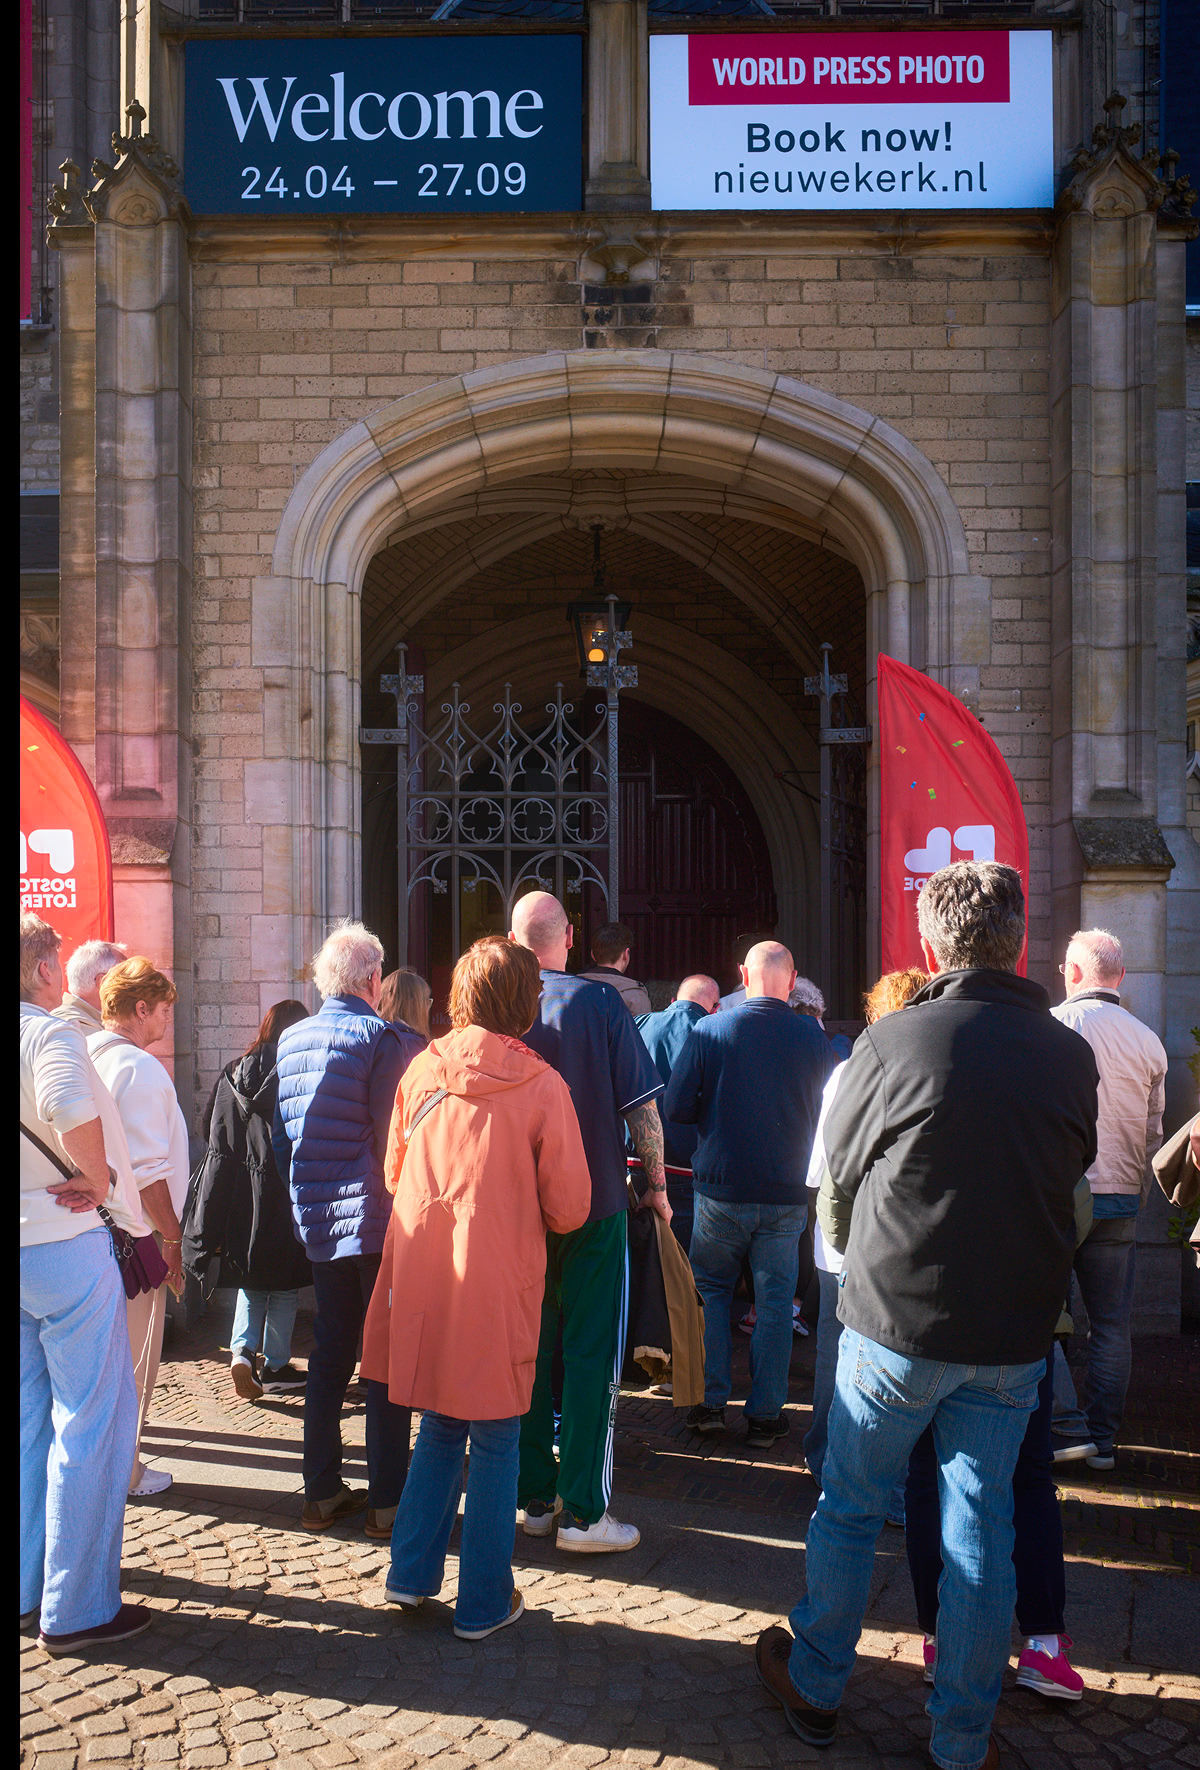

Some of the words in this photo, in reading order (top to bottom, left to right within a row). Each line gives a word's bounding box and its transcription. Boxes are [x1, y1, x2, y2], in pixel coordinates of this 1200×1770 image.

[712, 57, 806, 86] WORLD
[813, 56, 891, 85] PRESS
[898, 55, 985, 84] PHOTO
[215, 71, 544, 143] Welcome
[746, 121, 847, 153] Book
[861, 121, 952, 152] now!
[241, 165, 355, 199] 24.04
[418, 162, 526, 196] 27.09
[714, 161, 987, 193] nieuwekerk.nl
